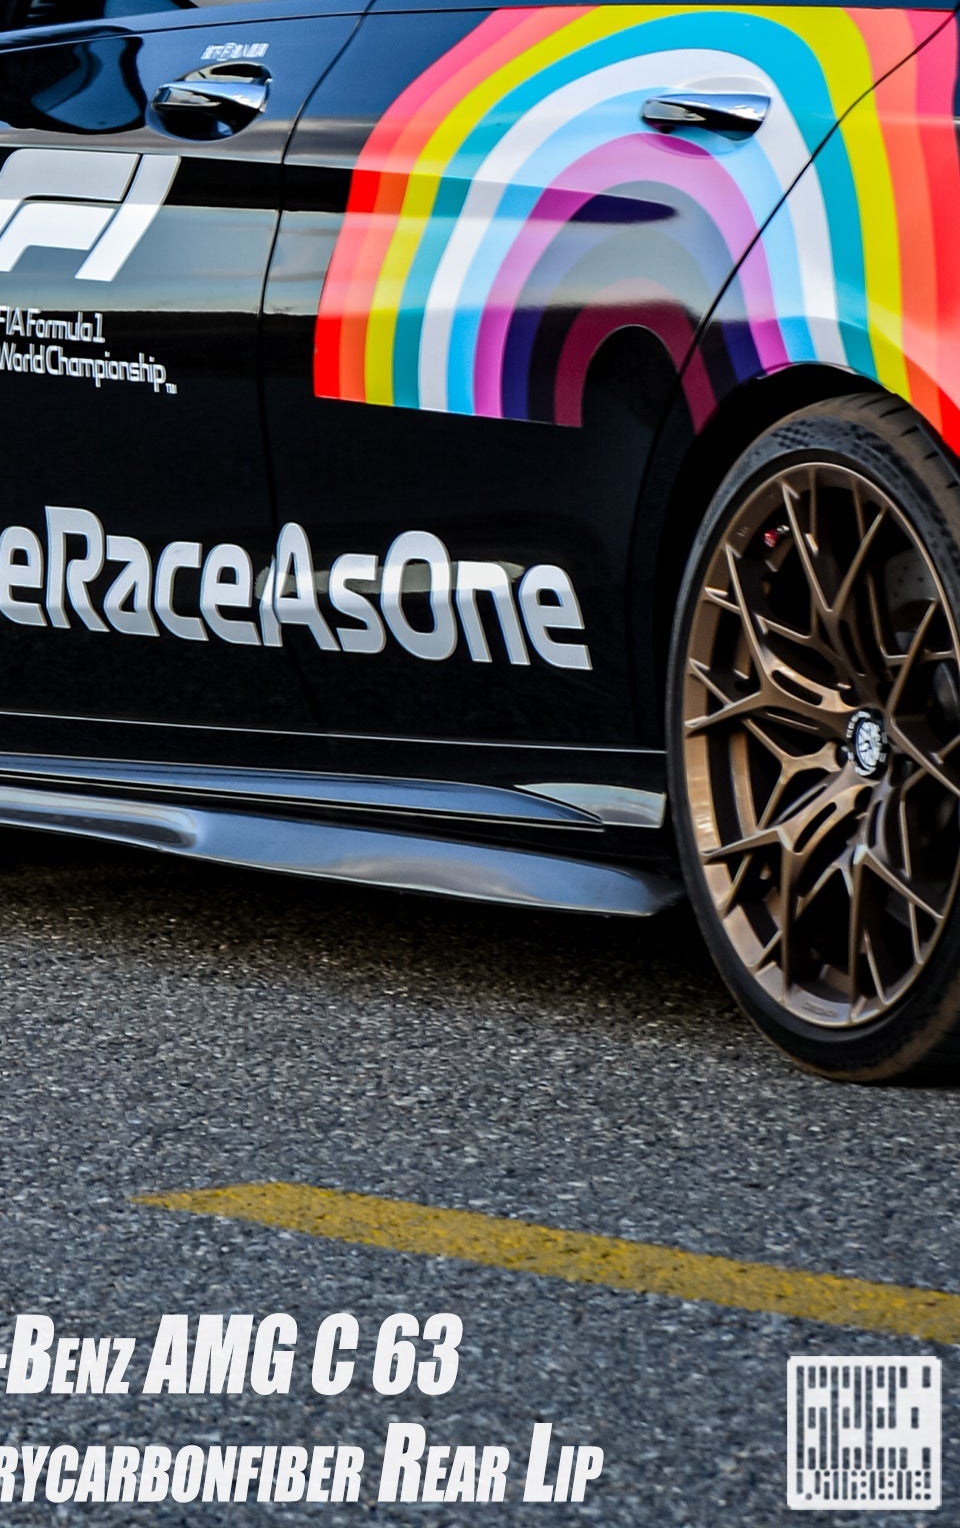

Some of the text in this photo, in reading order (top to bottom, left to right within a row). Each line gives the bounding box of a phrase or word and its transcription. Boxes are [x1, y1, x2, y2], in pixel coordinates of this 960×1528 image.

[26, 307, 94, 343] Formula
[92, 312, 106, 344] 1
[45, 344, 167, 393] Championship
